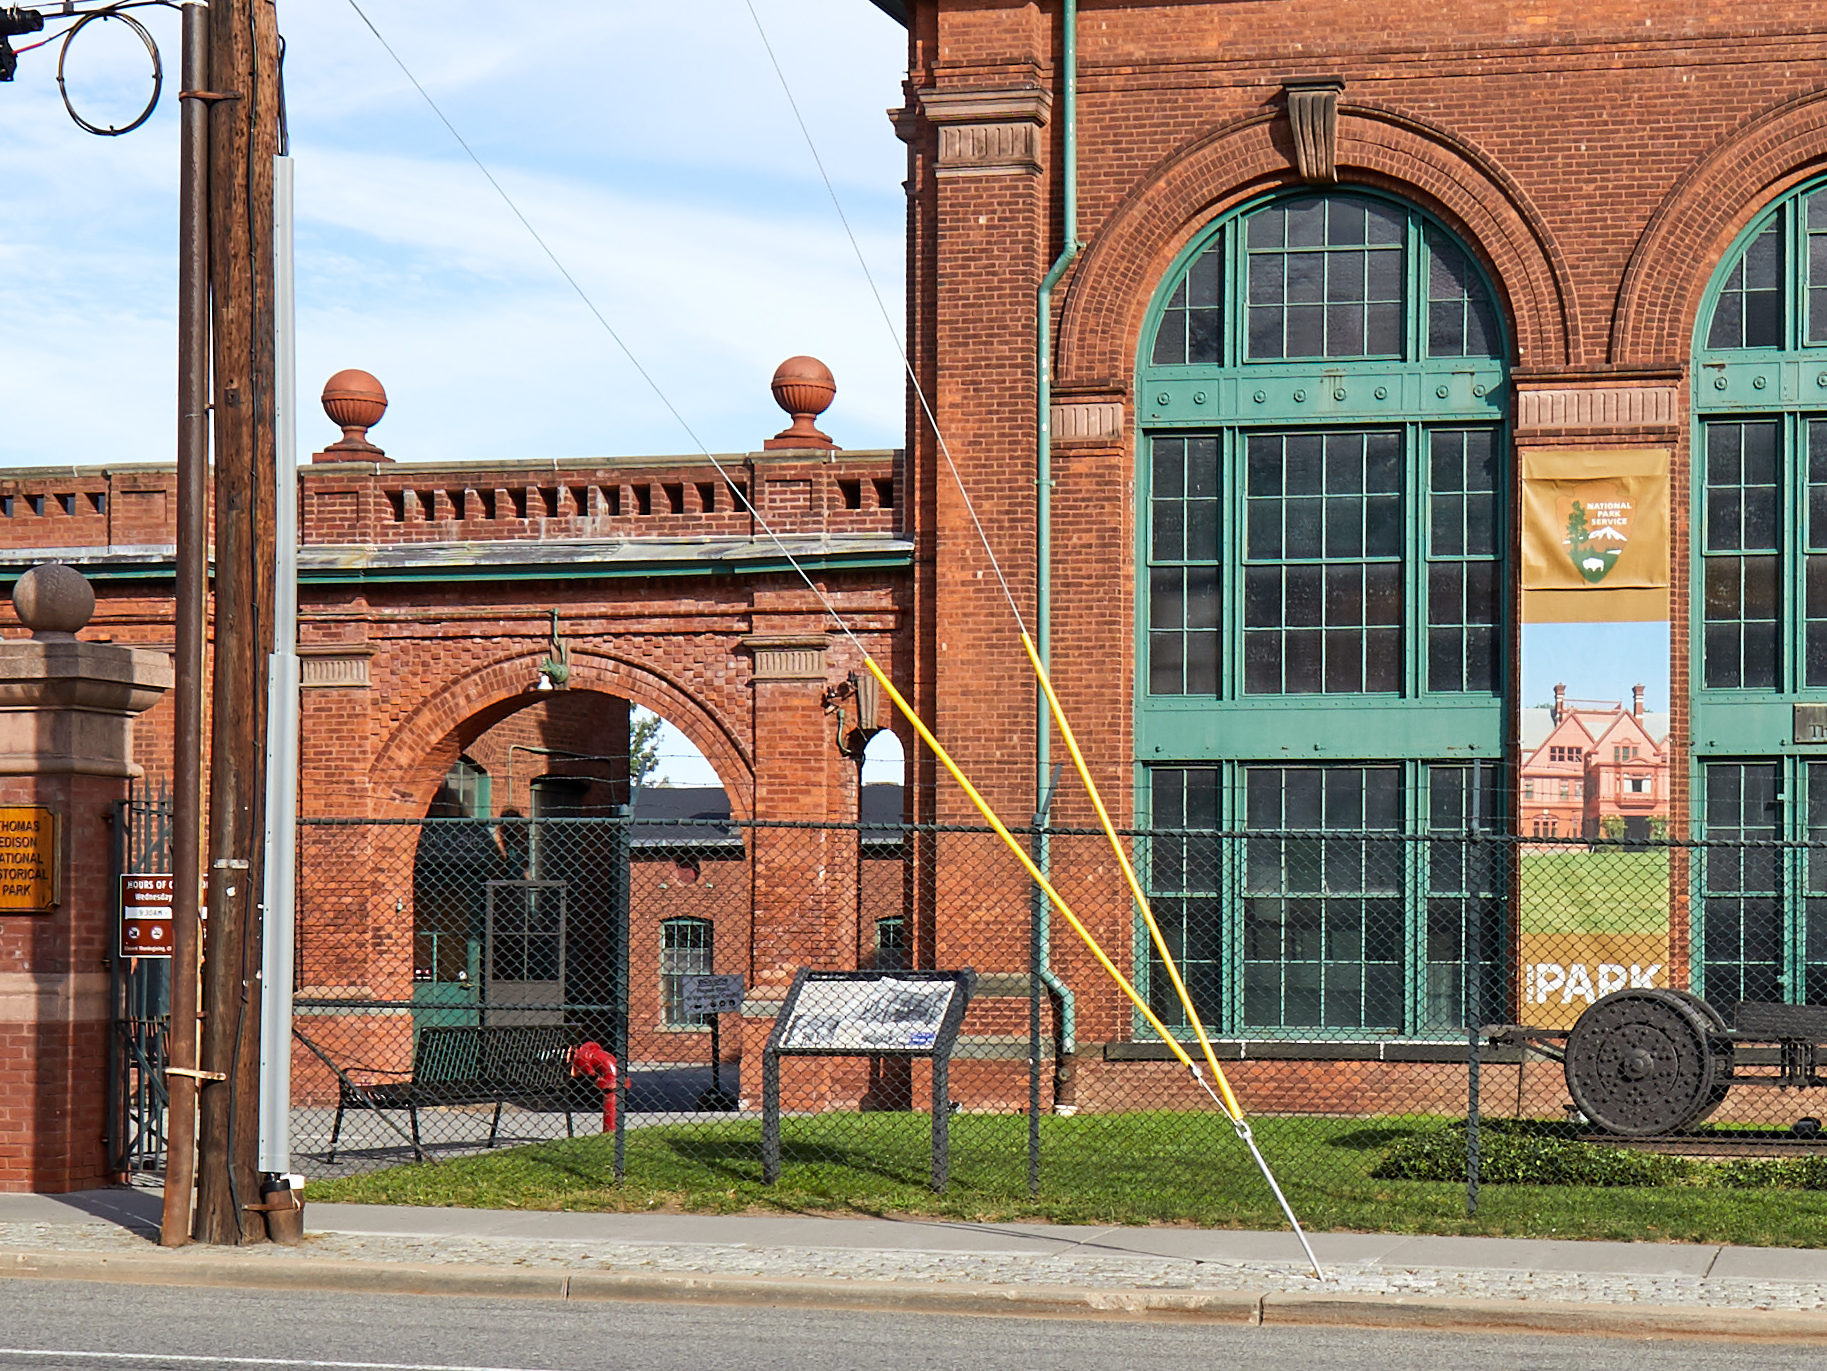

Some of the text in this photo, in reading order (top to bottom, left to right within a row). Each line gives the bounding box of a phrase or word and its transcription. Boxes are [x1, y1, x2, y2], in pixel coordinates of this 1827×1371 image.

[1587, 502, 1632, 510] NATIONAL
[127, 880, 154, 889] HOURS
[156, 880, 166, 889] OF
[2, 884, 31, 896] PARK
[135, 893, 173, 902] Wednesday
[1536, 963, 1662, 1004] PARK
